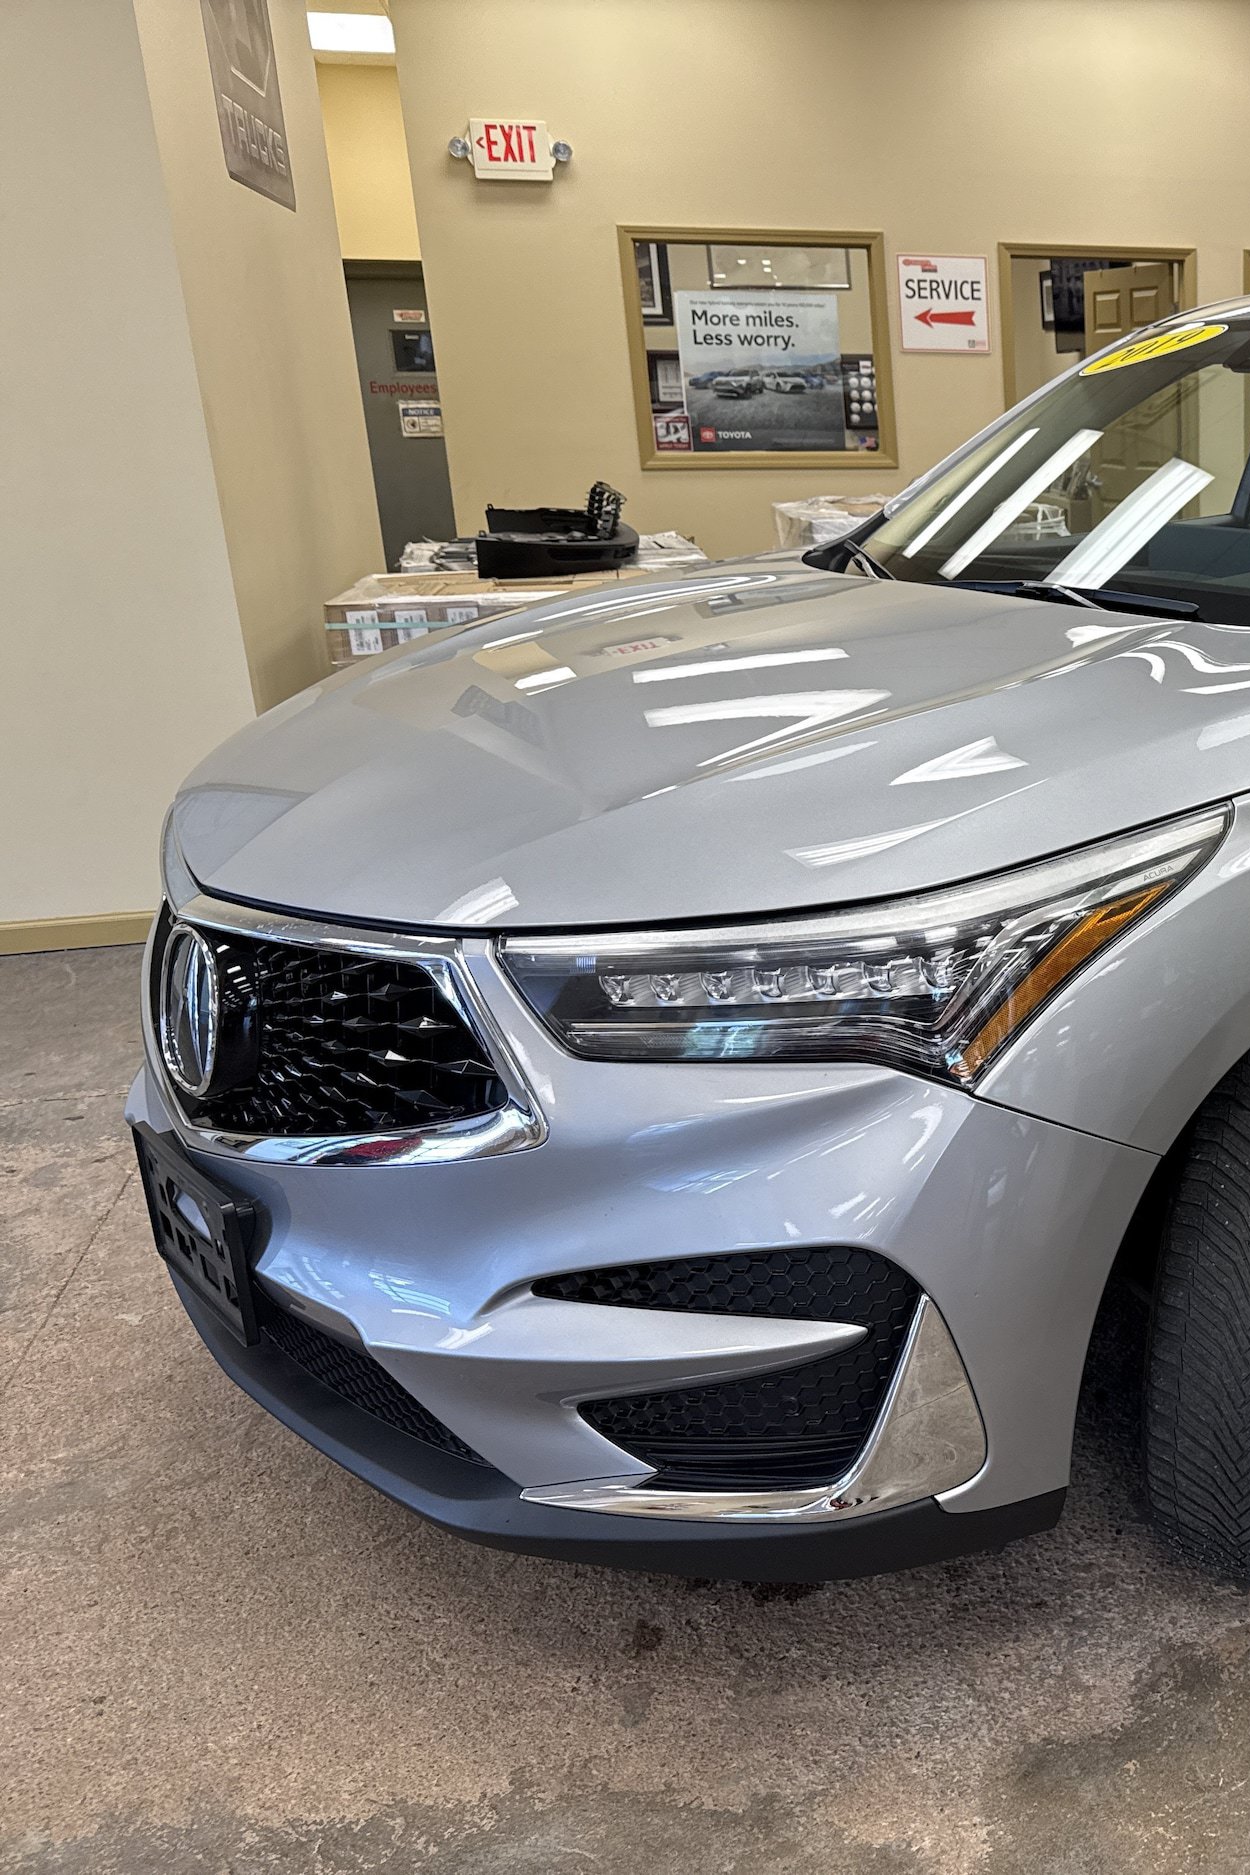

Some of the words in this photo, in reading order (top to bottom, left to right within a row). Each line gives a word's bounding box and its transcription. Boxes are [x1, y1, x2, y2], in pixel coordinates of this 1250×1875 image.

[221, 93, 287, 176] TRUCKS
[484, 124, 537, 163] EXIT
[905, 279, 982, 301] SERVICE
[691, 309, 741, 327] More
[745, 310, 799, 328] miles.
[693, 329, 733, 346] Less
[737, 334, 795, 351] worry.
[370, 381, 437, 396] Employees
[408, 408, 434, 416] NOTICE
[718, 430, 752, 440] TOYOTA
